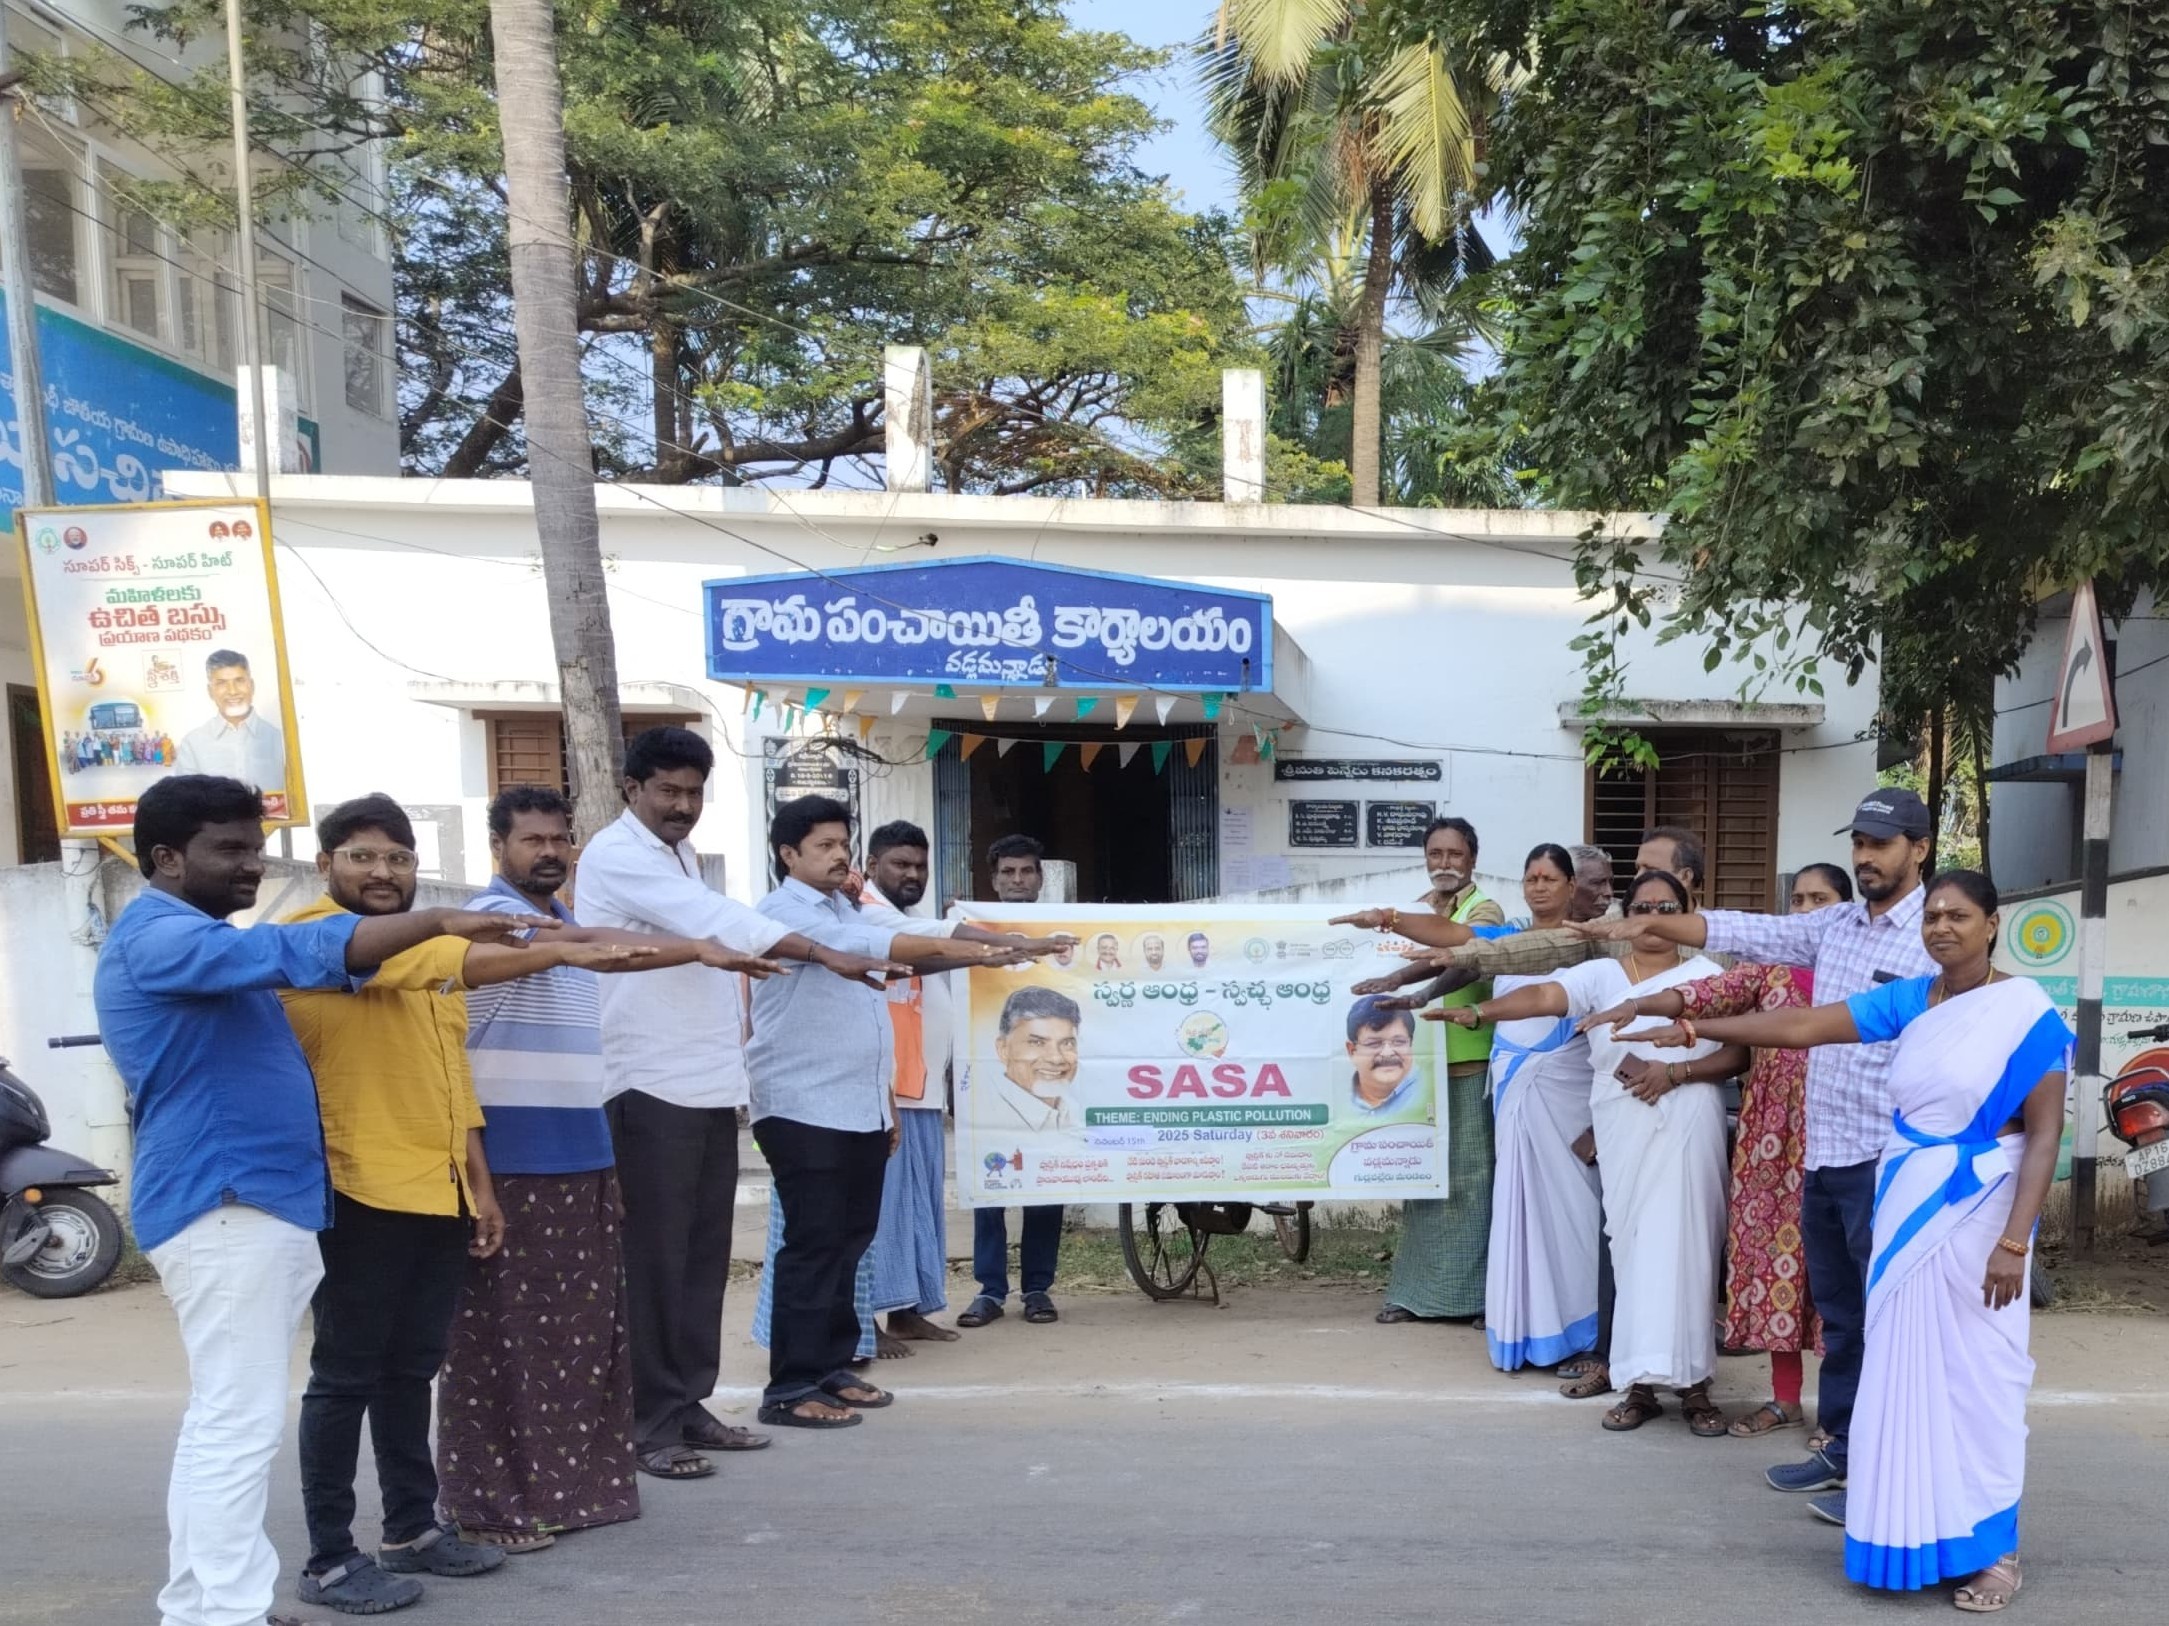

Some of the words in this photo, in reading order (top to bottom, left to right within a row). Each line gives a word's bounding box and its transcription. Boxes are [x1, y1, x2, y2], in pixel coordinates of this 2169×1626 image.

[63, 556, 111, 574] సూపర్
[114, 555, 141, 576] సిక్స్
[152, 553, 197, 571] సూపర్
[201, 551, 233, 568] హిట్
[106, 584, 202, 605] మహిళలకు
[88, 605, 161, 629] ఉచిత
[167, 602, 227, 631] బస్సు
[99, 629, 160, 647] ప్రయాణ
[164, 627, 212, 644] పథకం
[721, 594, 820, 652] గ్రామ
[825, 594, 1042, 648] పంచాయితీ
[1051, 605, 1252, 667] కార్యాలయం
[1094, 981, 1136, 1008] స్వర్ణ
[1142, 981, 1199, 1005] ఆంధ్ర
[1276, 980, 1331, 1004] ఆంధ్ర
[1126, 1063, 1292, 1099] SASA
[1095, 1112, 1140, 1124] THEME:
[1143, 1111, 1189, 1123] ENDING
[1193, 1110, 1242, 1122] PLASTIC
[1245, 1109, 1312, 1121] POLLUTION
[1157, 1129, 1189, 1142] 2025
[1193, 1128, 1253, 1143] Saturday
